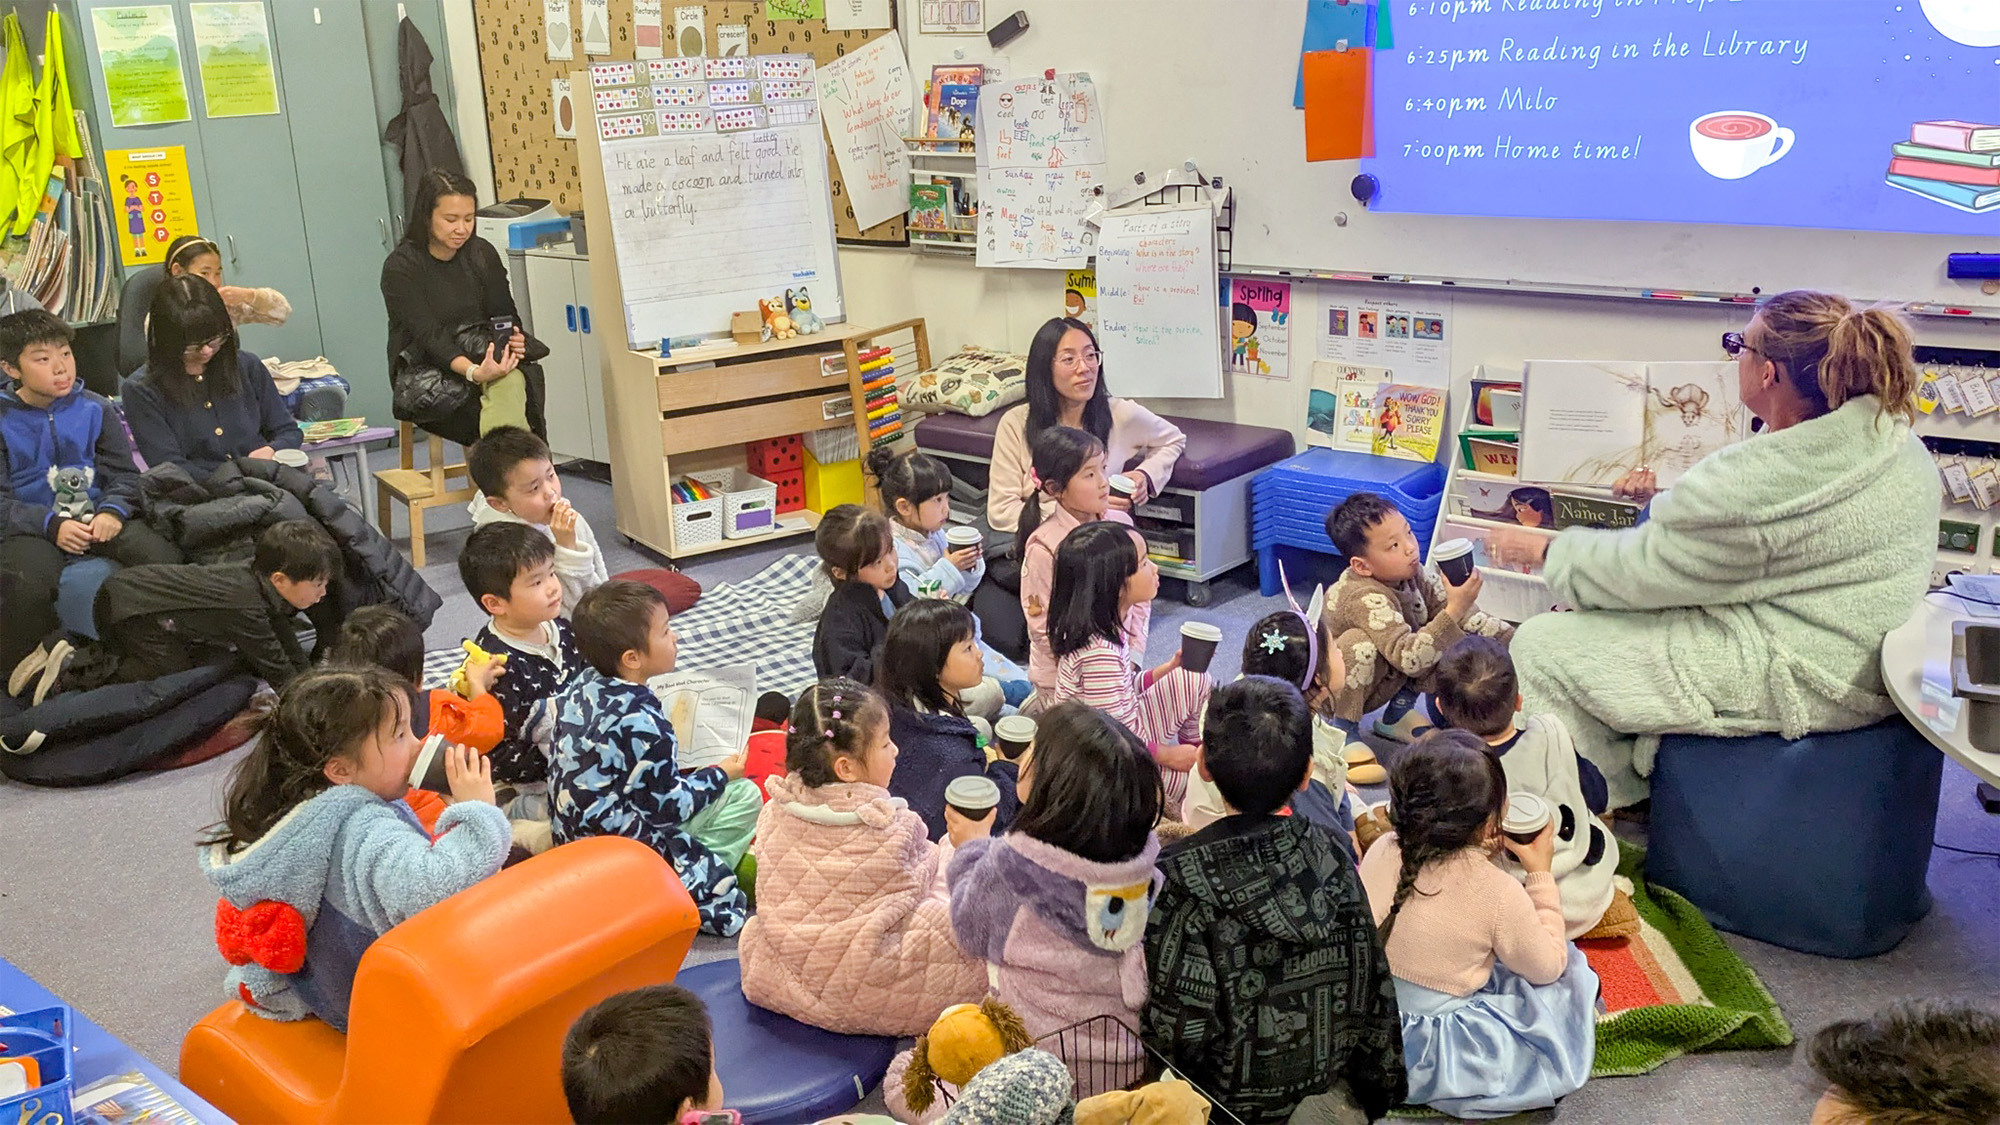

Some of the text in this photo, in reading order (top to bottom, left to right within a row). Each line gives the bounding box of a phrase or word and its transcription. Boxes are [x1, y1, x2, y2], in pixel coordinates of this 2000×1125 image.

[549, 4, 565, 13] Heart
[634, 6, 660, 17] Rectangle
[680, 11, 700, 21] Circle
[719, 30, 746, 39] crescent
[1407, 29, 1809, 71] 6:25pm Reading in the Library
[951, 96, 968, 108] Dogs
[1405, 86, 1560, 119] 6:40pm Milo
[675, 145, 697, 169] leaf
[702, 144, 723, 162] and
[727, 140, 749, 165] felt
[1403, 134, 1642, 166] 7:00pm Home time!
[149, 175, 156, 184] S
[622, 174, 653, 195] made
[672, 177, 714, 192] cocoon
[719, 165, 742, 185] and
[749, 160, 783, 184] turned
[151, 193, 159, 203] T
[1038, 195, 1052, 210] ay
[154, 212, 163, 221] O
[1001, 207, 1018, 228] May
[1122, 218, 1146, 233] Parts
[1149, 222, 1158, 233] of
[1170, 216, 1192, 235] story
[158, 230, 165, 239] P
[1166, 249, 1176, 257] the
[1099, 285, 1130, 297] Middle:
[1240, 284, 1283, 308] Spring
[1103, 319, 1130, 337] Ending:
[1258, 321, 1287, 333] September
[1262, 335, 1287, 344] October
[1259, 347, 1287, 357] November
[1399, 391, 1441, 409] WOW GOD!
[1404, 404, 1440, 418] THANK YOU
[1405, 413, 1432, 426] SORRY
[1406, 424, 1432, 438] PLEASE
[1559, 501, 1637, 528] Name Jar
[687, 679, 710, 687] Character
